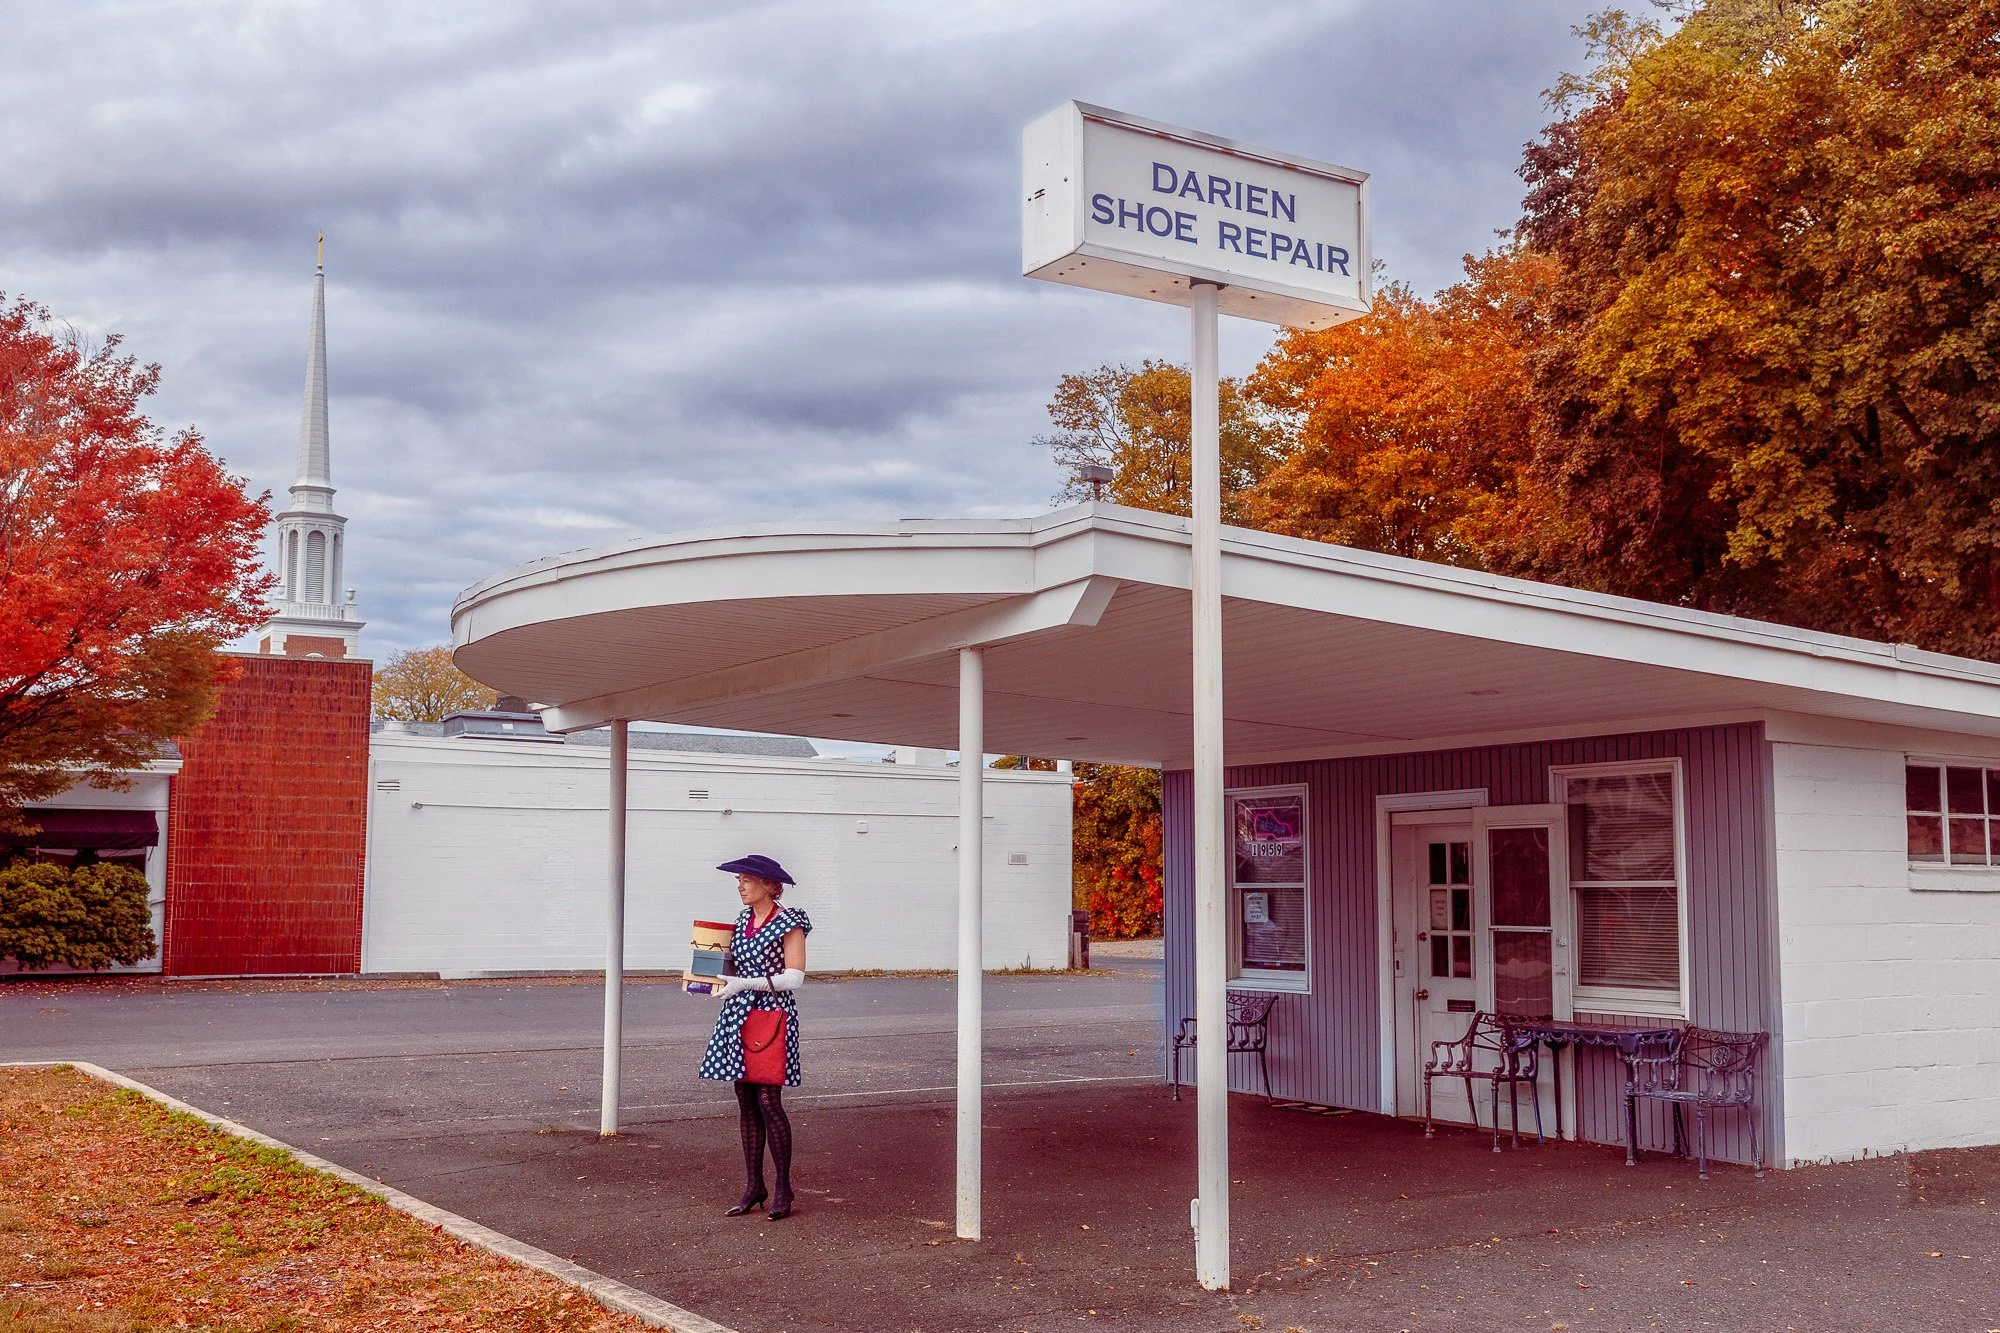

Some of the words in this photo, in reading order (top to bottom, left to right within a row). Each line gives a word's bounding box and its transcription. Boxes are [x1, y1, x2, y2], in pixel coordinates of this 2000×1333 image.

[1152, 162, 1296, 223] DARIEN
[1091, 194, 1198, 244] SHOE
[1218, 220, 1350, 277] REPAIR
[1260, 820, 1286, 835] REPAIR
[1252, 844, 1282, 856] 1959
